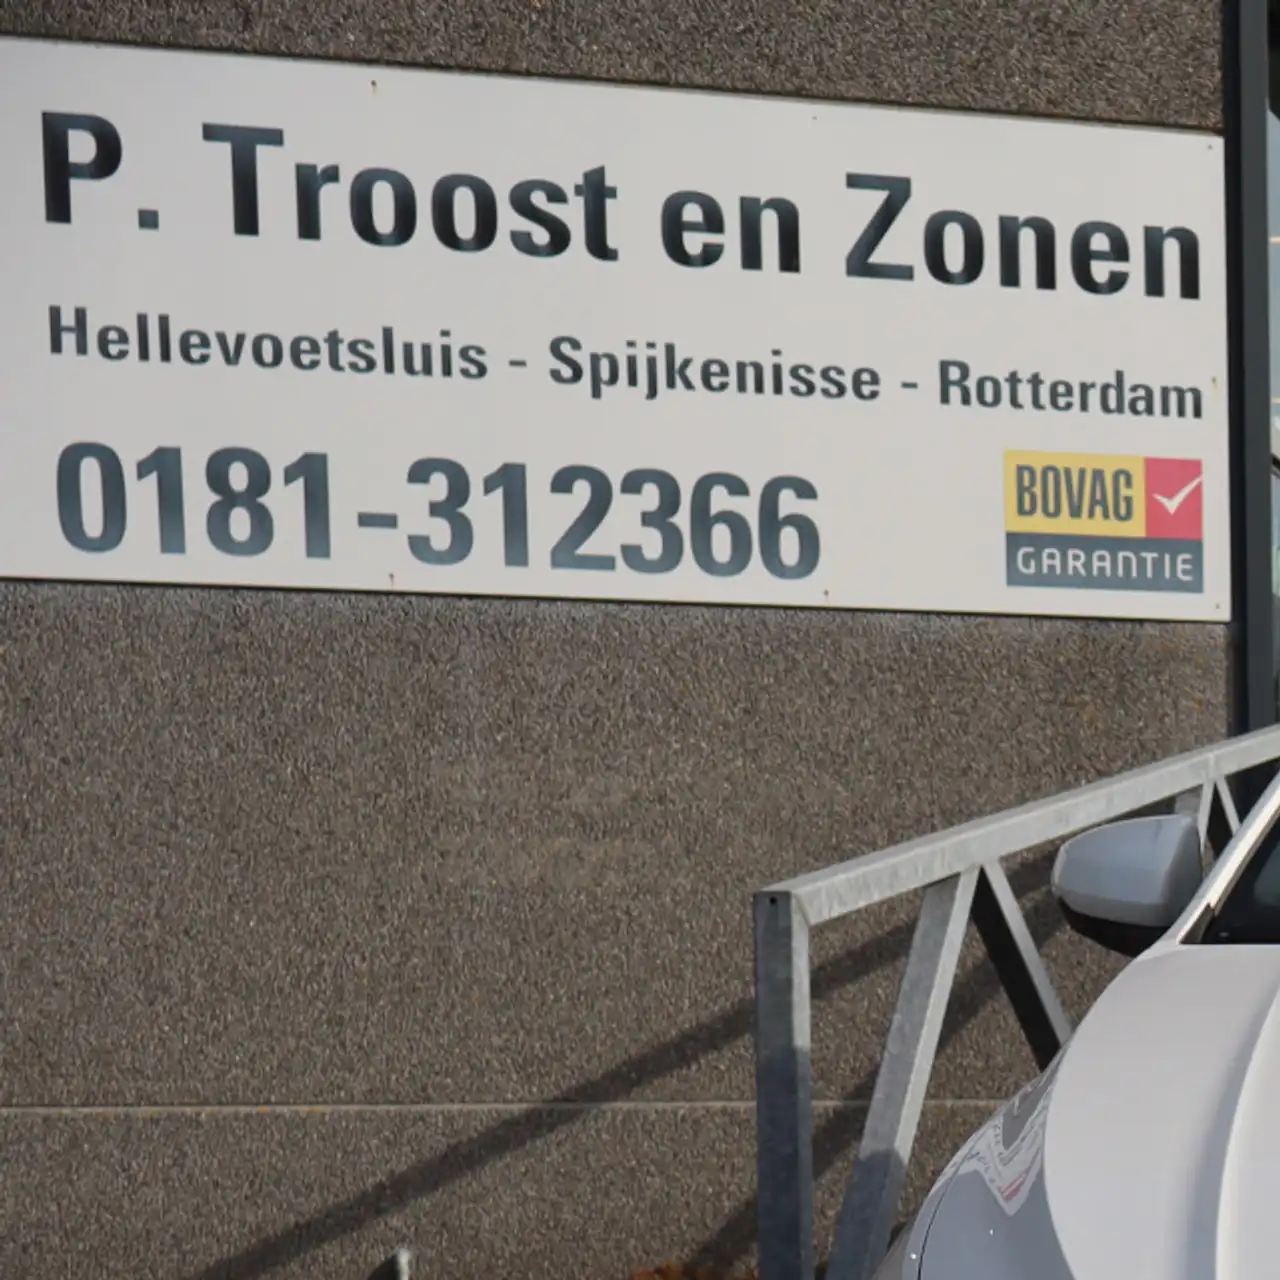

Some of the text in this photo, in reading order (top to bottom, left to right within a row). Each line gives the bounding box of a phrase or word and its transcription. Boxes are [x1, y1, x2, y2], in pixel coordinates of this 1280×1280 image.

[42, 111, 1199, 299] P. Troost en Zonen
[49, 306, 487, 378] Hellevoetsluis
[550, 336, 879, 400] Spijkenisse
[940, 360, 1202, 418] Rotterdam
[57, 442, 819, 578] 0181-312366
[1017, 466, 1132, 521] BOVAG
[1017, 547, 1192, 581] GARANTIE
